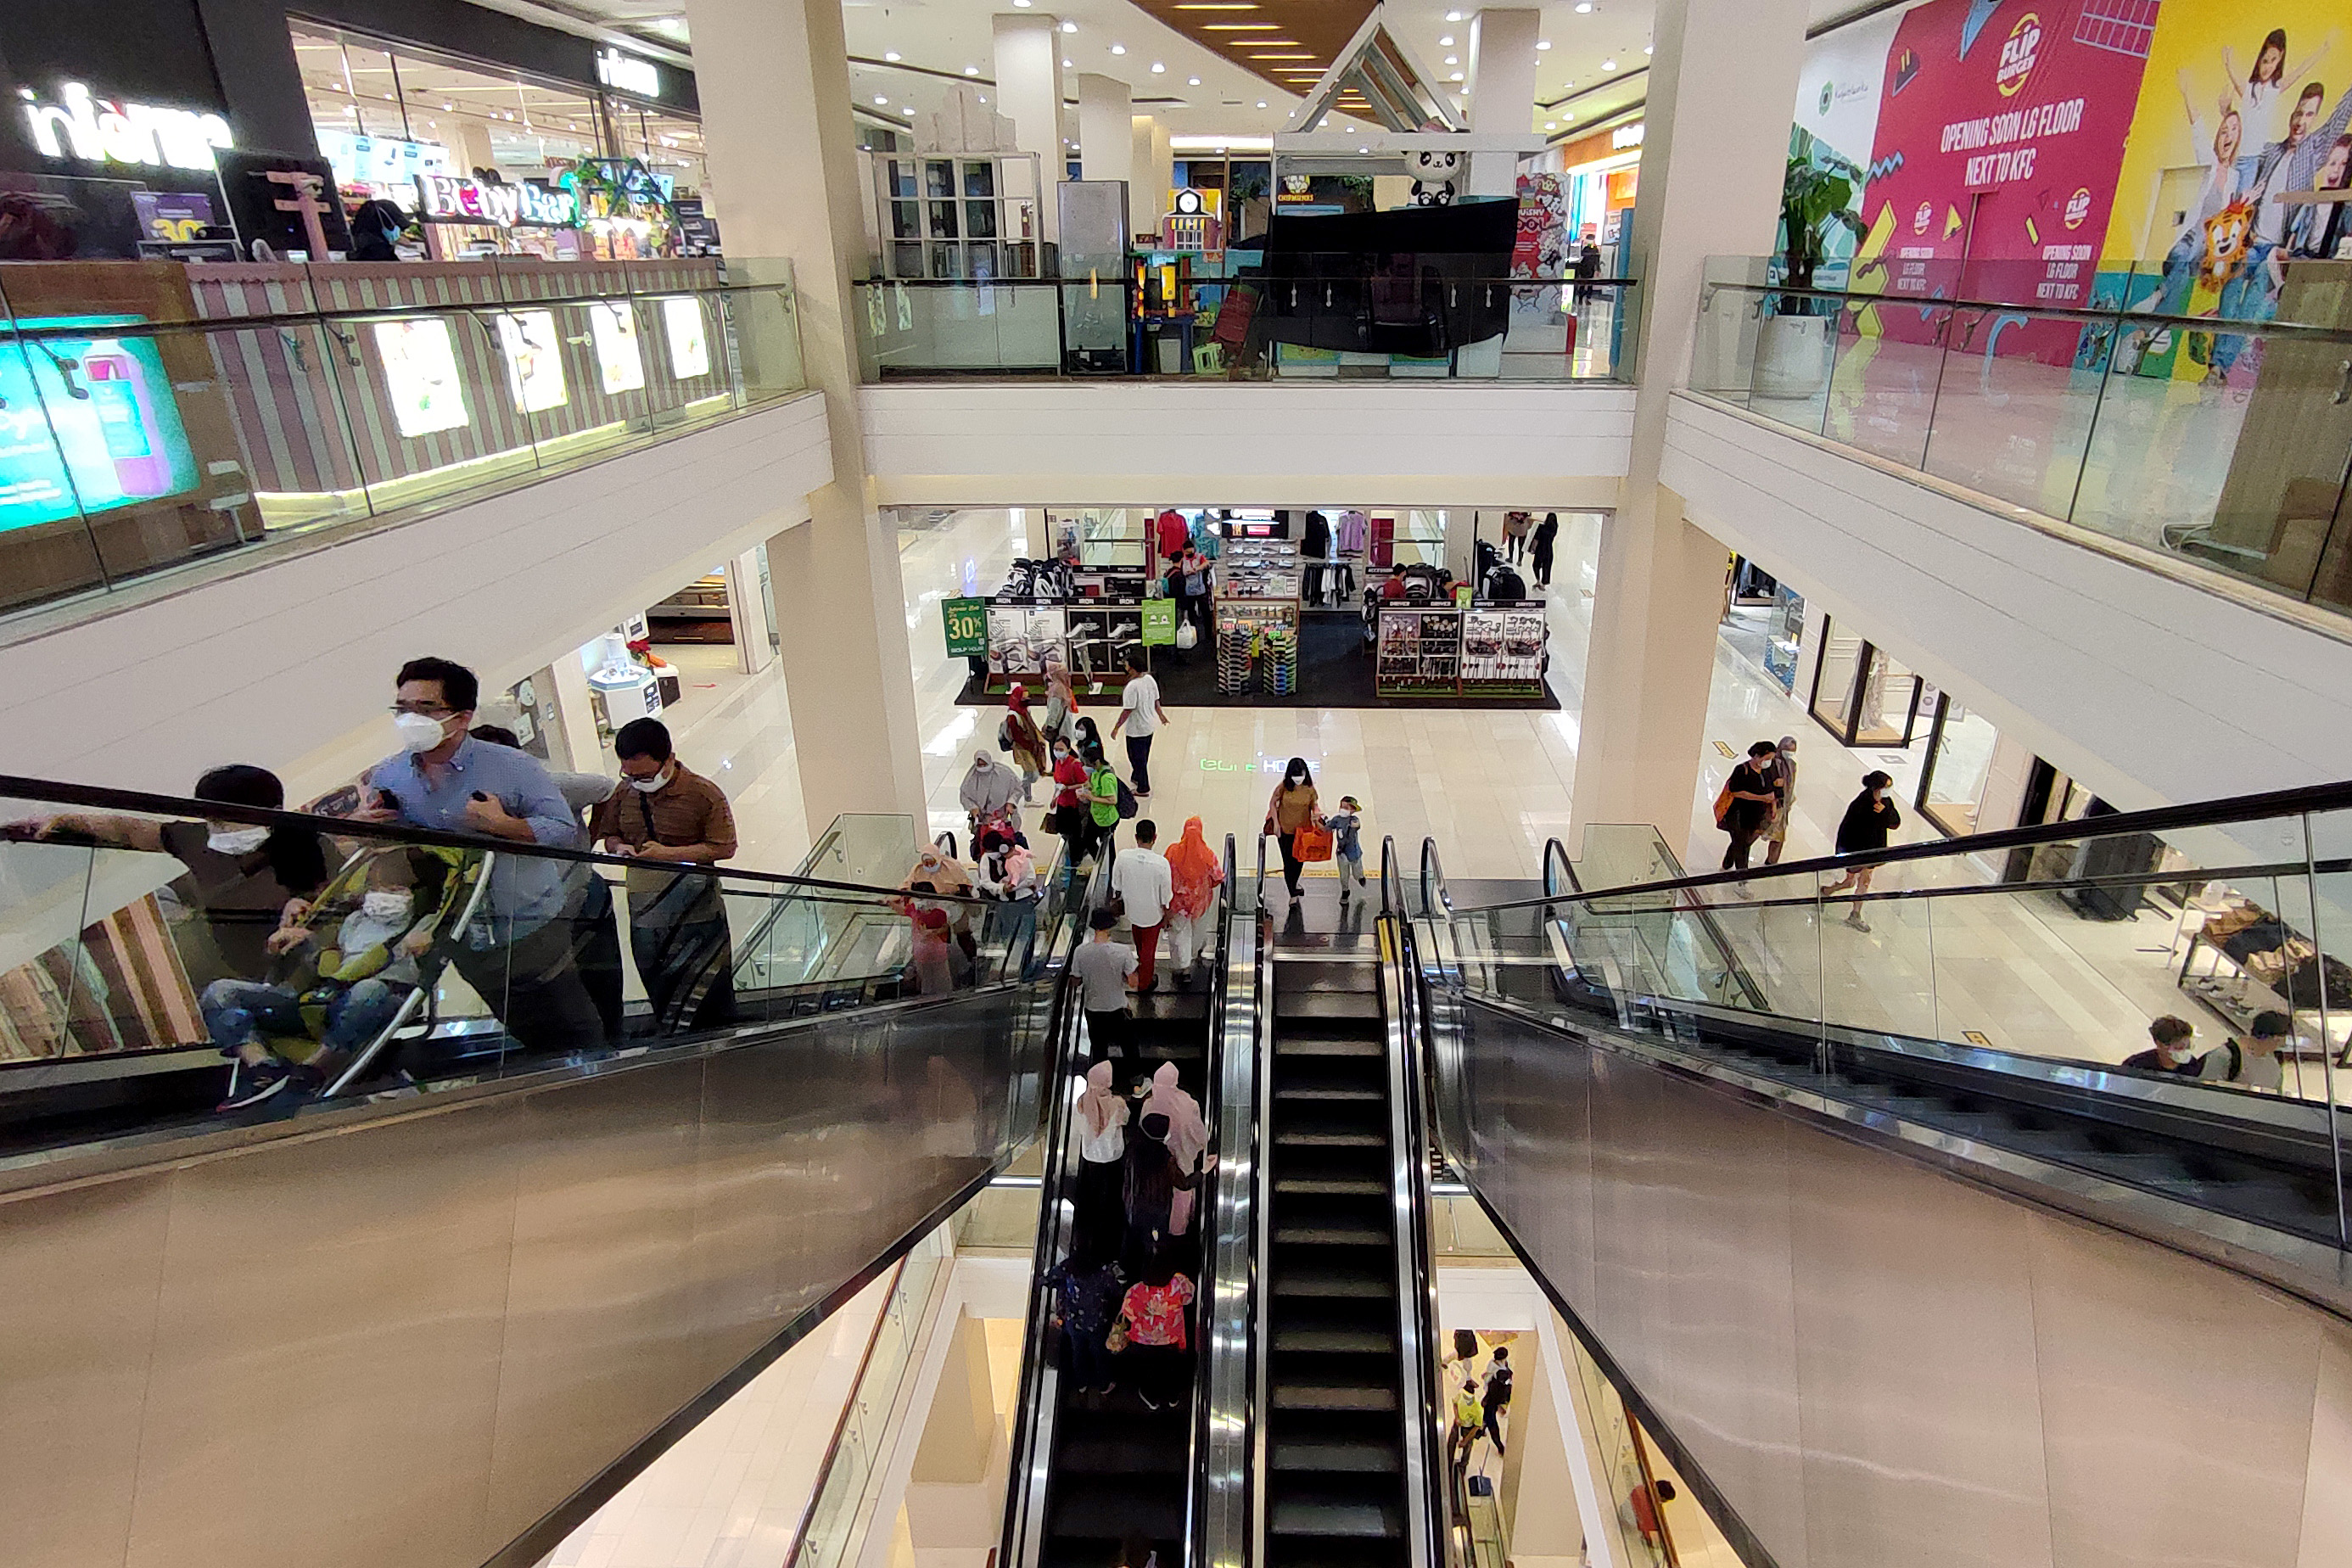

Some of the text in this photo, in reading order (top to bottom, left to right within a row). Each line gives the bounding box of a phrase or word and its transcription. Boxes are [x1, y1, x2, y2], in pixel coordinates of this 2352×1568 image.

[1940, 98, 2085, 154] OPENING SOON LG FLOOR
[1964, 148, 2036, 187] NEXT TO KFC
[2070, 244, 2092, 260] SOON
[2055, 262, 2079, 279] FLOOR
